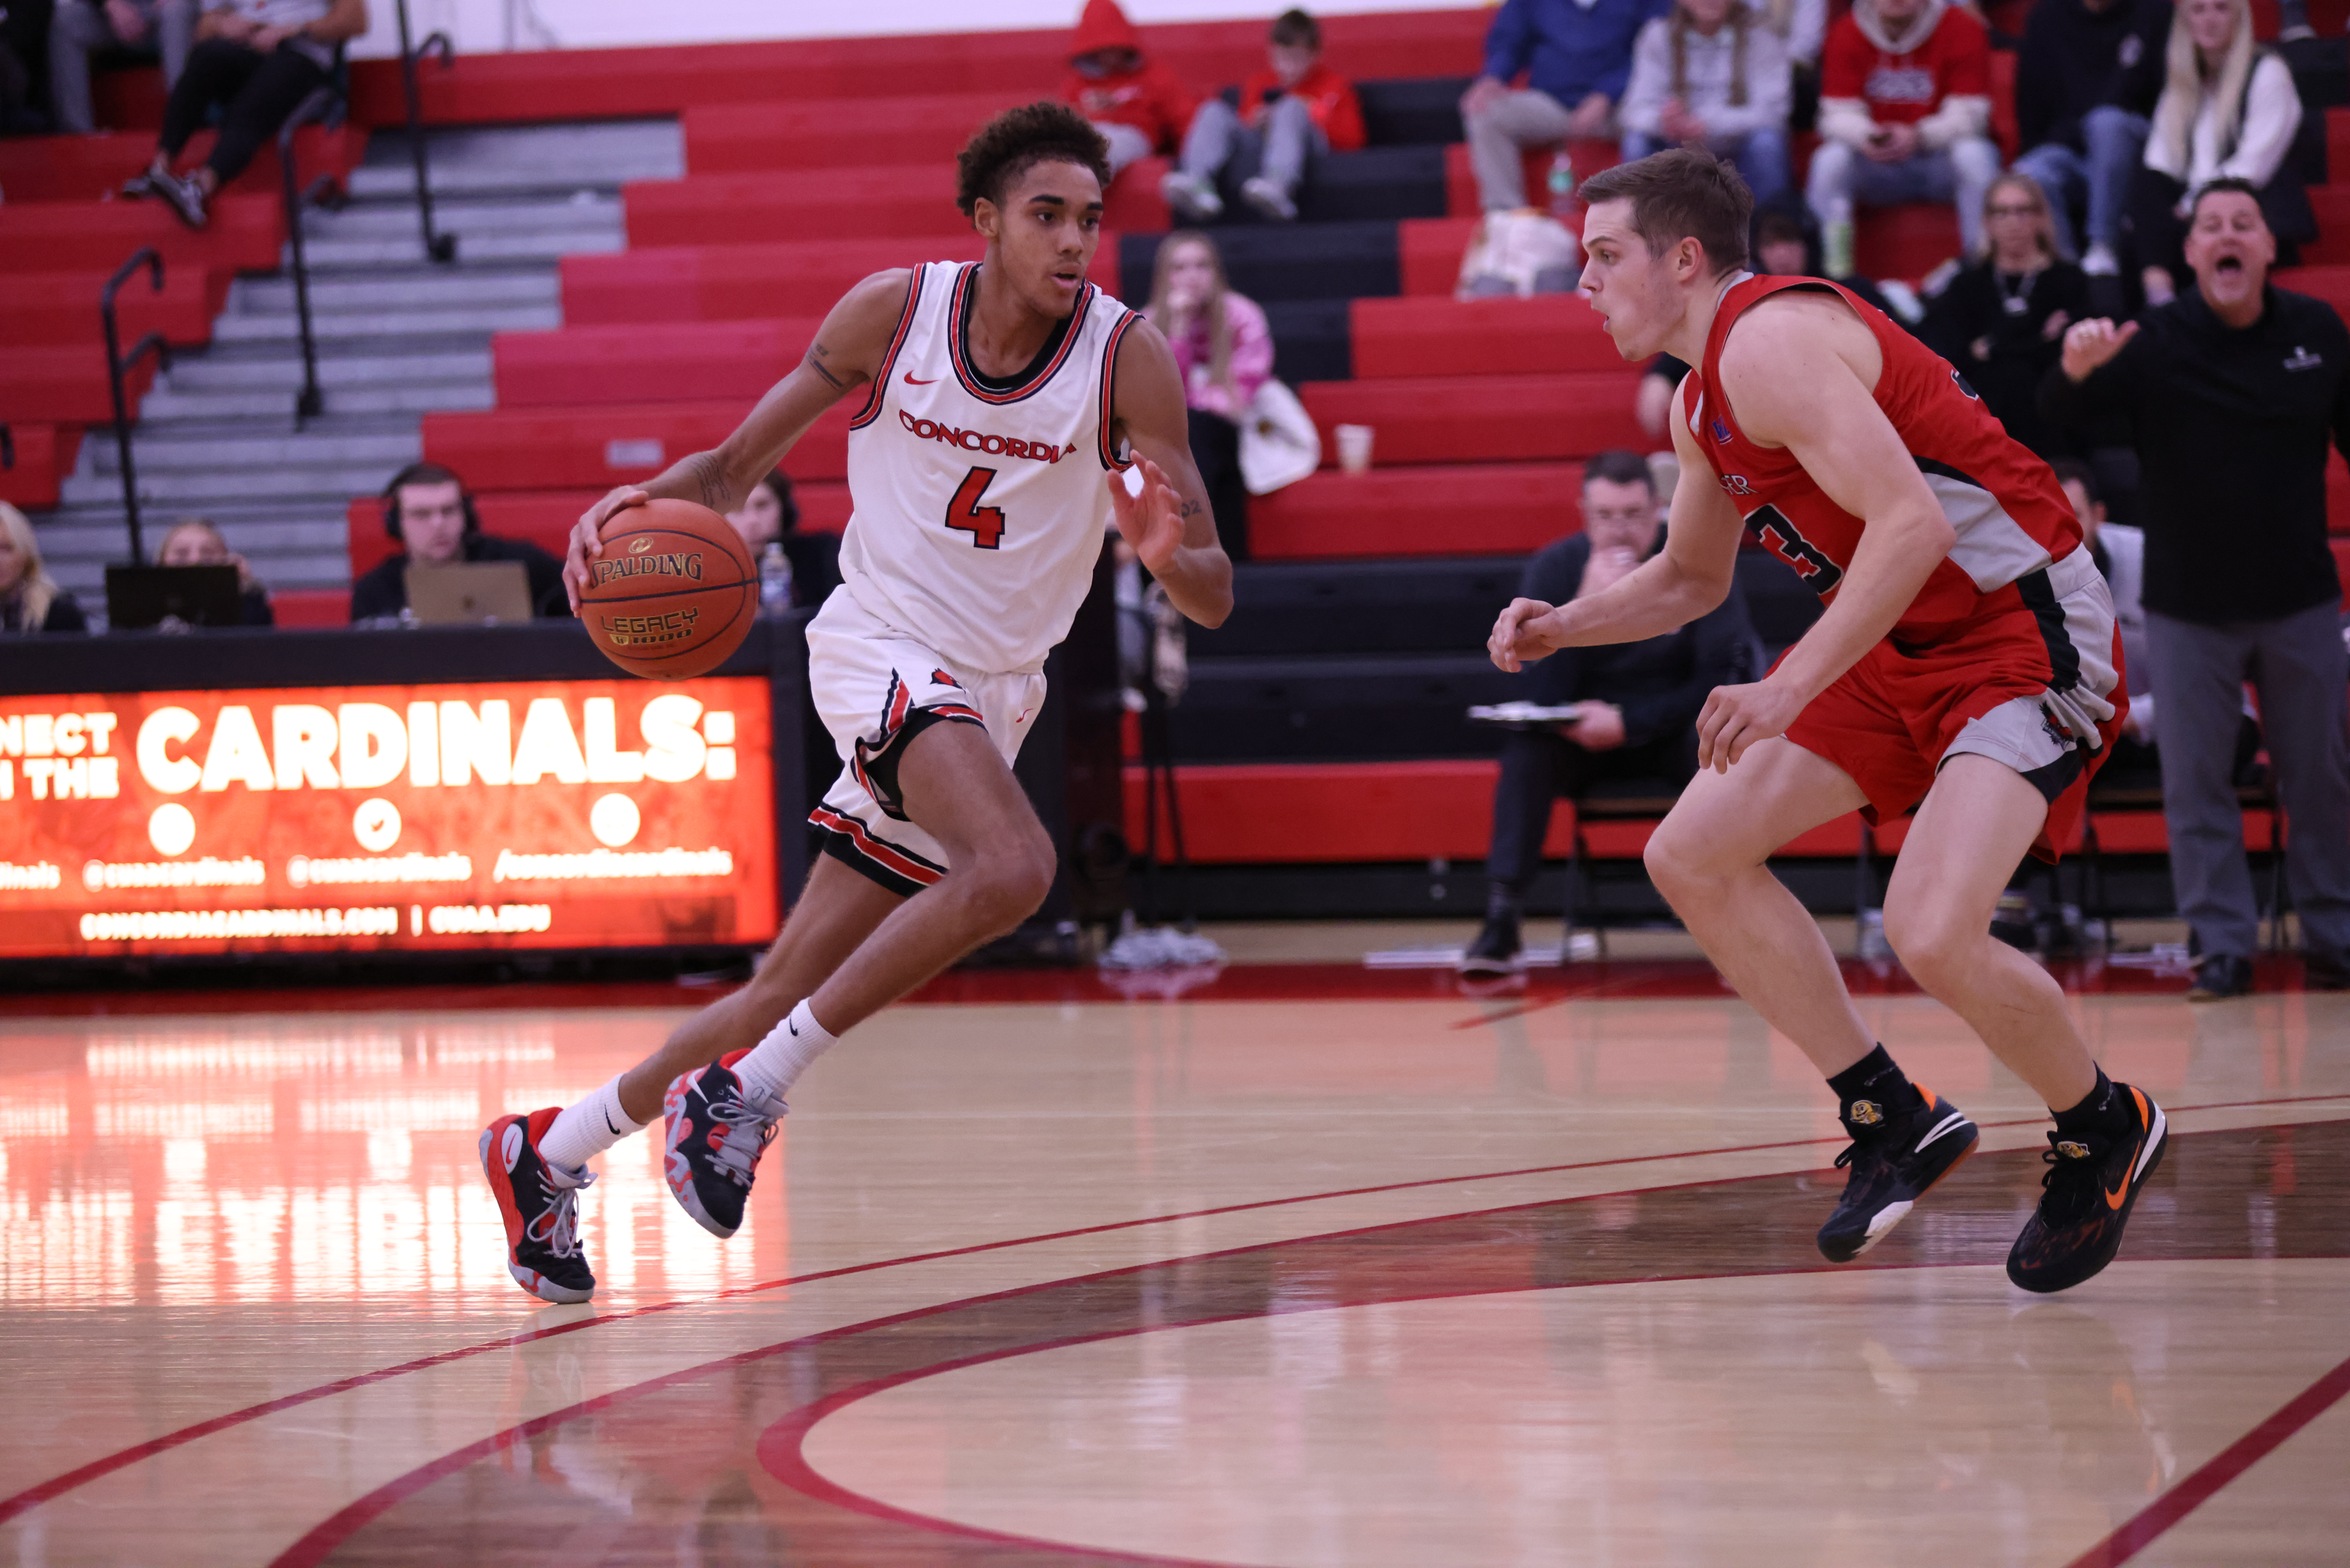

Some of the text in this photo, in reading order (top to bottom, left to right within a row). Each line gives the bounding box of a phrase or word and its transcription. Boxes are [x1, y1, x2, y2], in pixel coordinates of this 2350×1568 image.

[945, 465, 1006, 550] 4
[591, 552, 703, 590] SPALDING
[601, 606, 699, 634] LEGACY
[136, 694, 737, 794] CARDINALS:
[23, 757, 120, 800] THE
